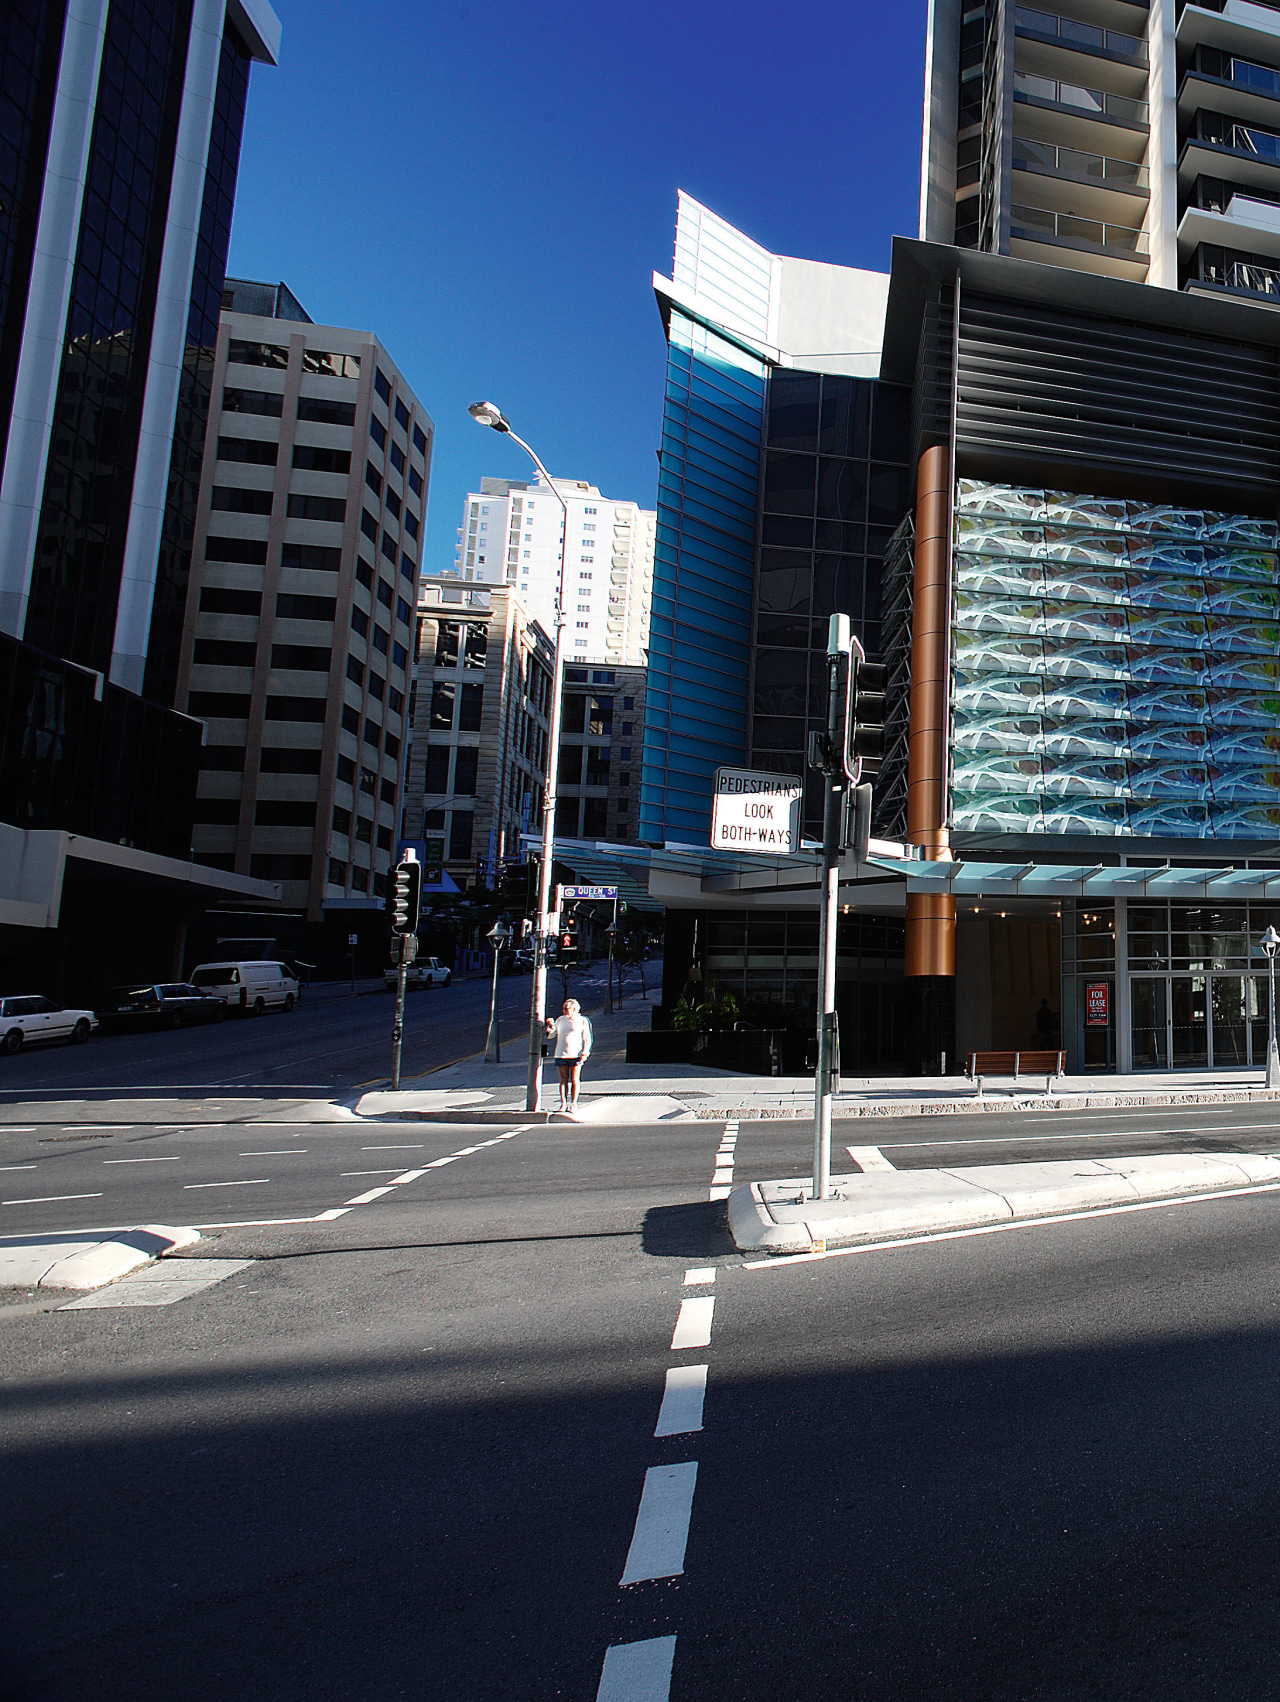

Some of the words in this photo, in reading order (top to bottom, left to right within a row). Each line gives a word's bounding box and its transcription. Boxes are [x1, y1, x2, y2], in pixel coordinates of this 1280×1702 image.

[719, 776, 799, 798] PEDESTRIANS
[744, 802, 774, 820] LOOK
[721, 824, 792, 845] BOTH-WAYS
[577, 887, 603, 895] QUEEN
[1091, 990, 1103, 999] FOR
[1089, 999, 1106, 1007] LEASE
